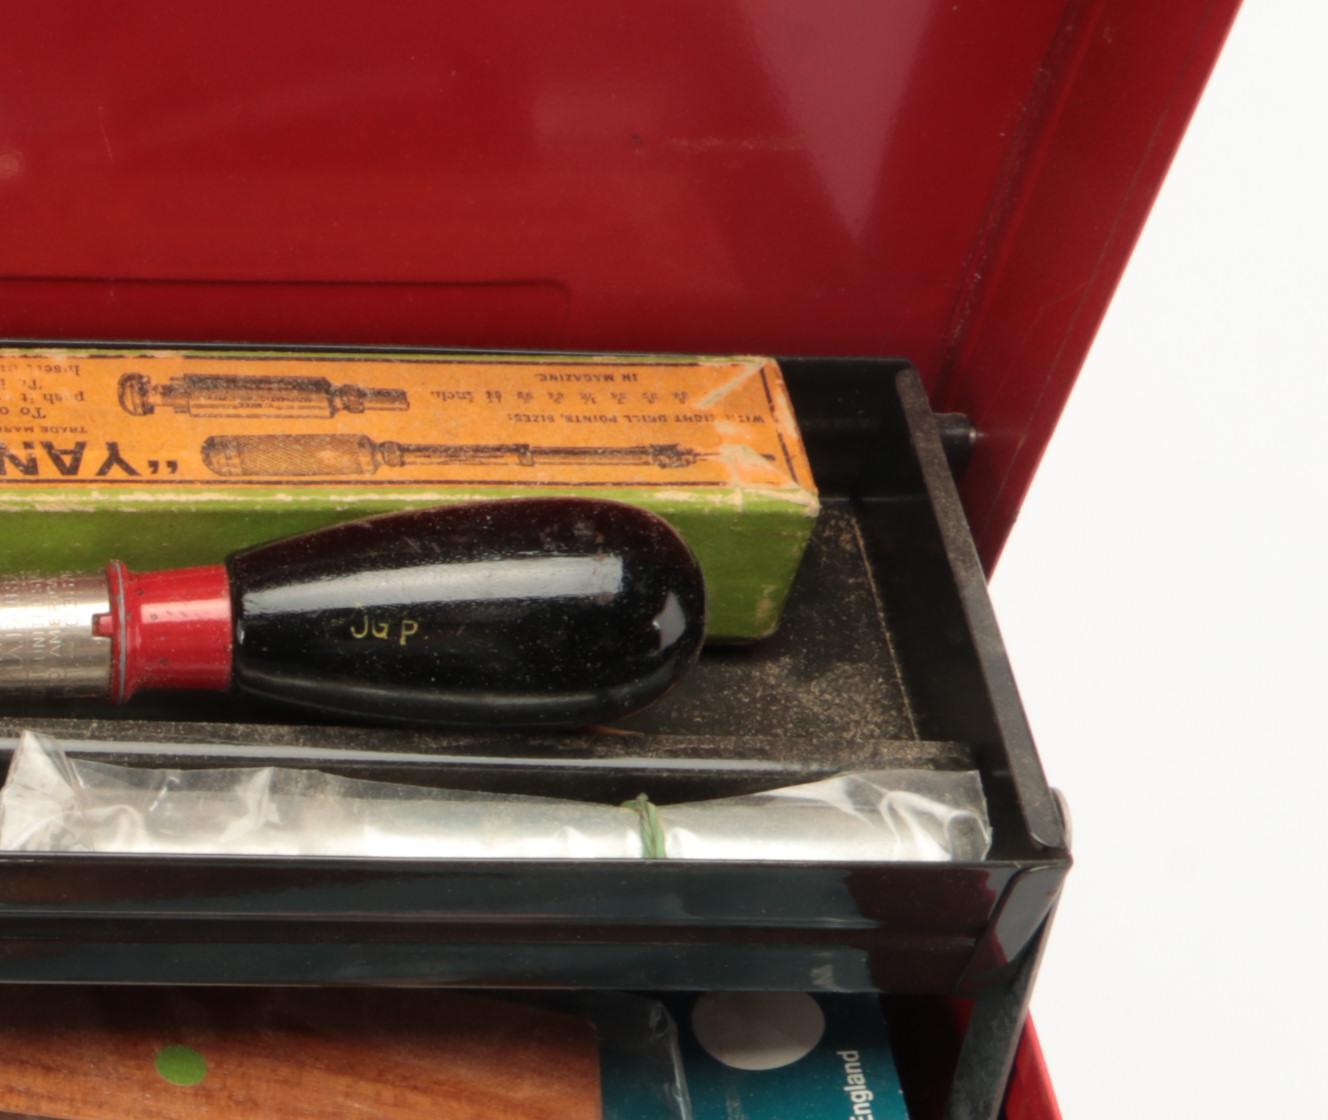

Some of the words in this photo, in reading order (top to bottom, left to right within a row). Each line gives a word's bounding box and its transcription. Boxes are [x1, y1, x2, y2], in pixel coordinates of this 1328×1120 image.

[621, 373, 638, 383] IN
[43, 391, 85, 404] psh
[20, 406, 46, 419] To
[42, 425, 87, 434] TRADE
